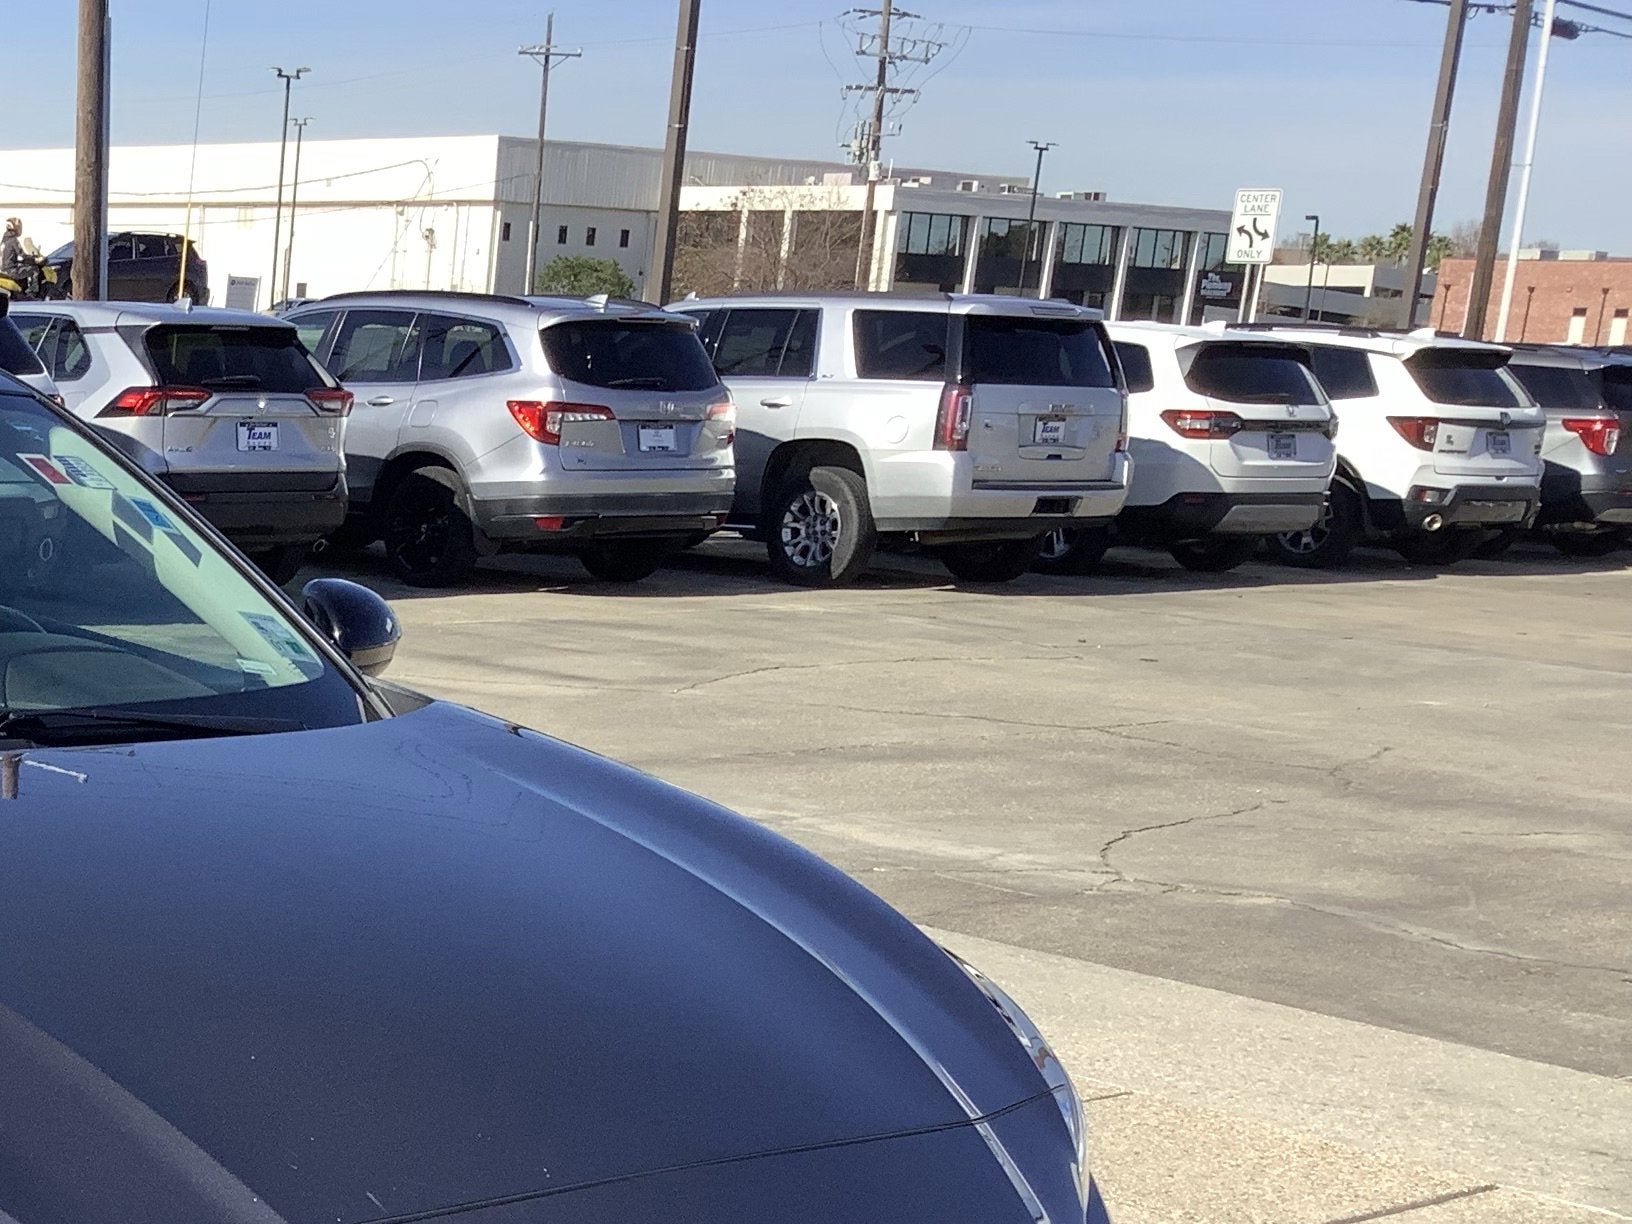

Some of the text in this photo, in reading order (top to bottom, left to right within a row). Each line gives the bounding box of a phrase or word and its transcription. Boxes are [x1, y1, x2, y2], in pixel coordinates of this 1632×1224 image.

[1240, 193, 1277, 204] CENTER
[1243, 204, 1270, 213] LANE
[1236, 249, 1262, 259] ONLY
[246, 428, 272, 440] TEAM
